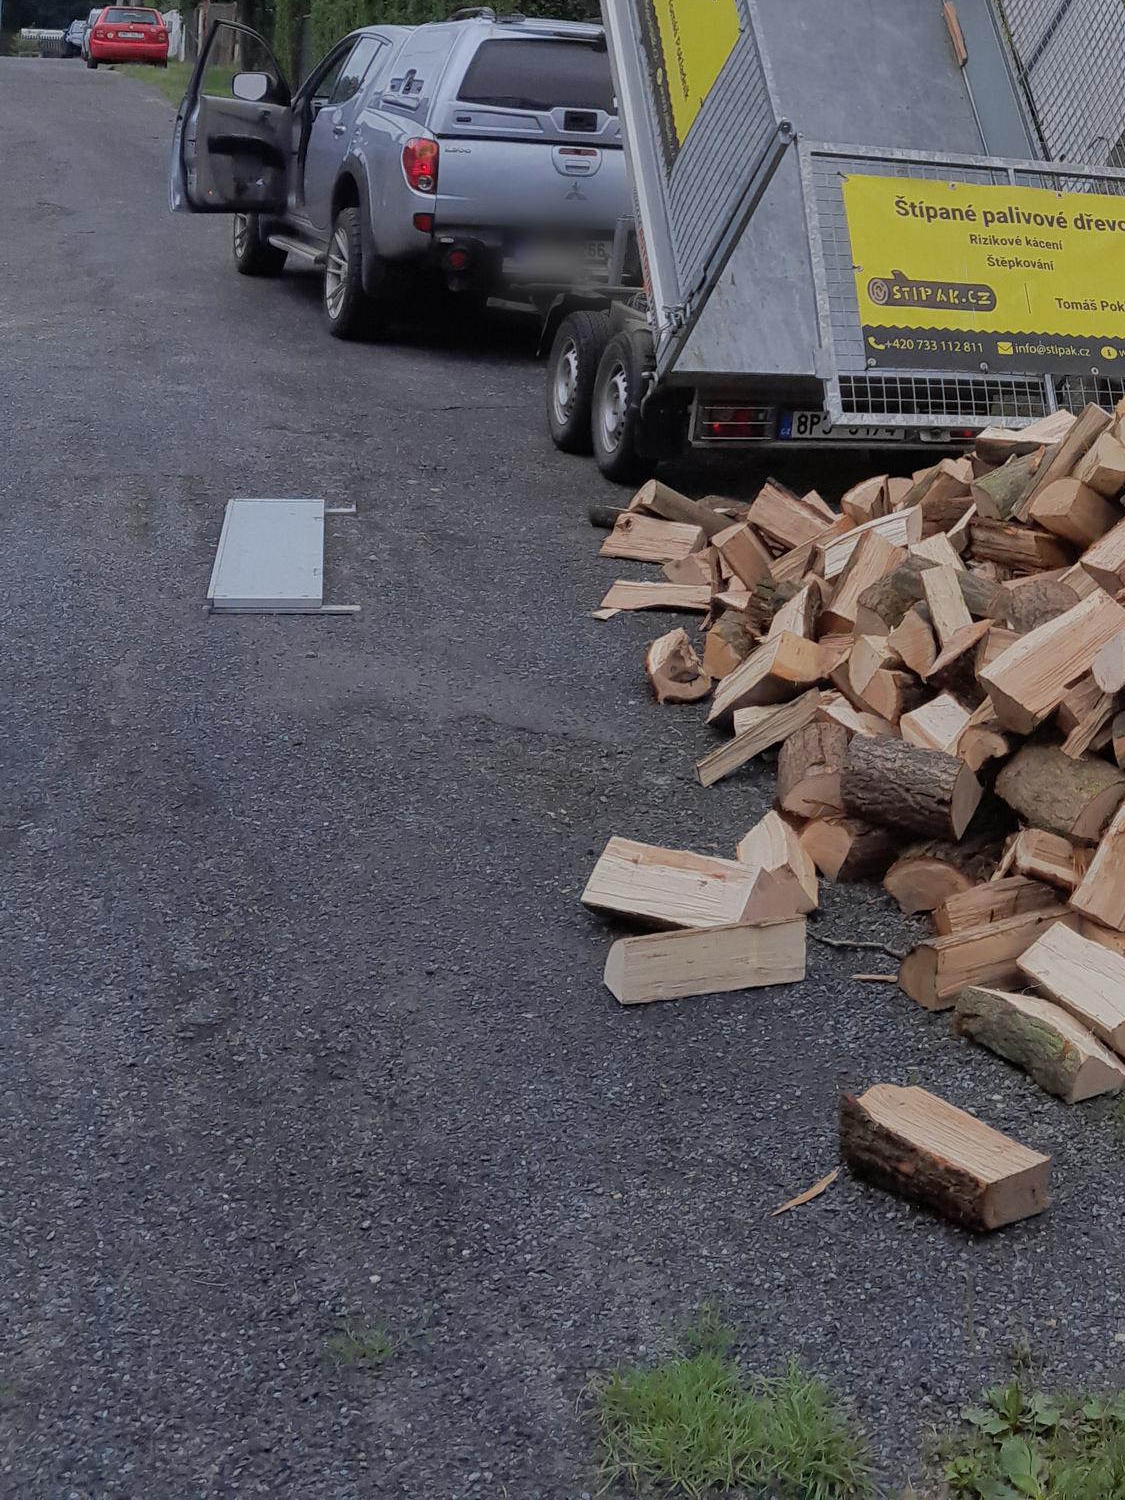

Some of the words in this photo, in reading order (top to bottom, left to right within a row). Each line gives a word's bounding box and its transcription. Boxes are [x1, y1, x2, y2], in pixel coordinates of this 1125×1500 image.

[894, 195, 977, 223] Štípané
[982, 206, 1068, 229] palivové
[969, 234, 1023, 246] Rizikové
[1024, 236, 1064, 251] kácení
[986, 254, 1055, 271] Štěpkování
[892, 285, 992, 305] STIPAK.CZ
[1055, 298, 1098, 311] Tomáš
[885, 339, 914, 349] +420
[916, 340, 938, 351] 733
[941, 341, 962, 352] 112
[963, 342, 984, 353] 811
[1015, 342, 1091, 357] info@stipak.cz
